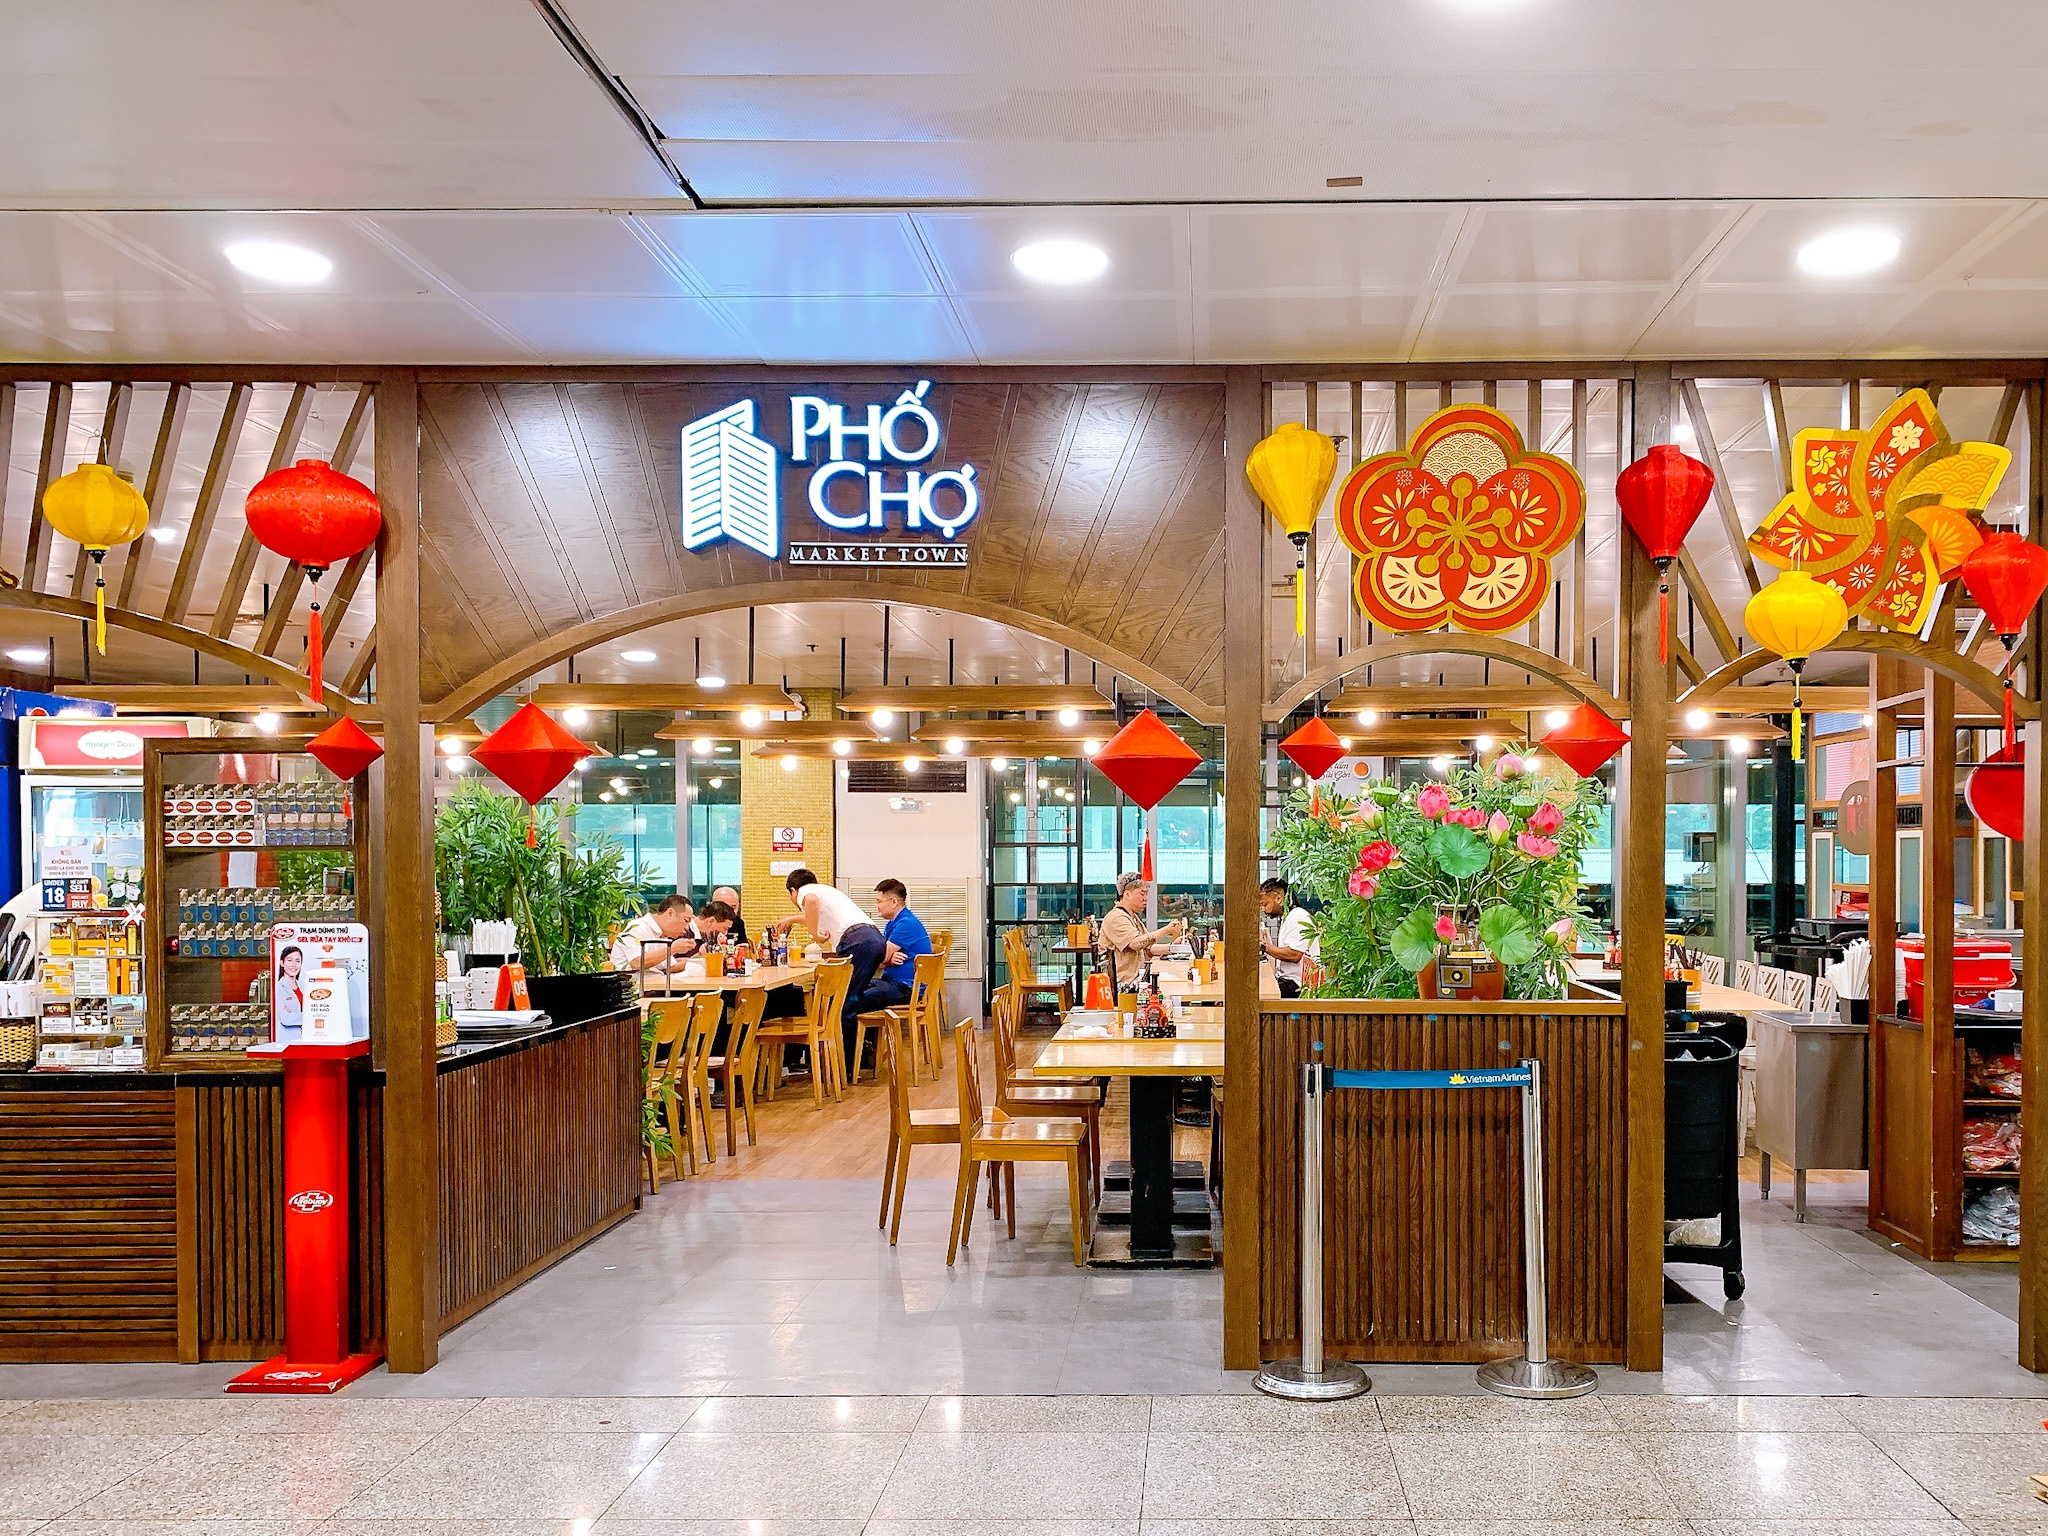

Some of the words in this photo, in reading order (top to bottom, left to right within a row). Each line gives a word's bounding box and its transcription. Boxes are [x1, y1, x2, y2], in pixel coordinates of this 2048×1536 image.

[790, 380, 939, 462] PHỐ
[808, 461, 979, 538] CHỢ
[789, 547, 885, 562] MARKET
[899, 547, 968, 562] TOWN
[45, 887, 65, 904] 18
[69, 884, 90, 893] SELL
[71, 900, 89, 909] BUY
[513, 980, 528, 996] 09
[1099, 986, 1111, 1000] 15
[1465, 1075, 1500, 1084] Vietnam
[1501, 1073, 1531, 1082] Airlines
